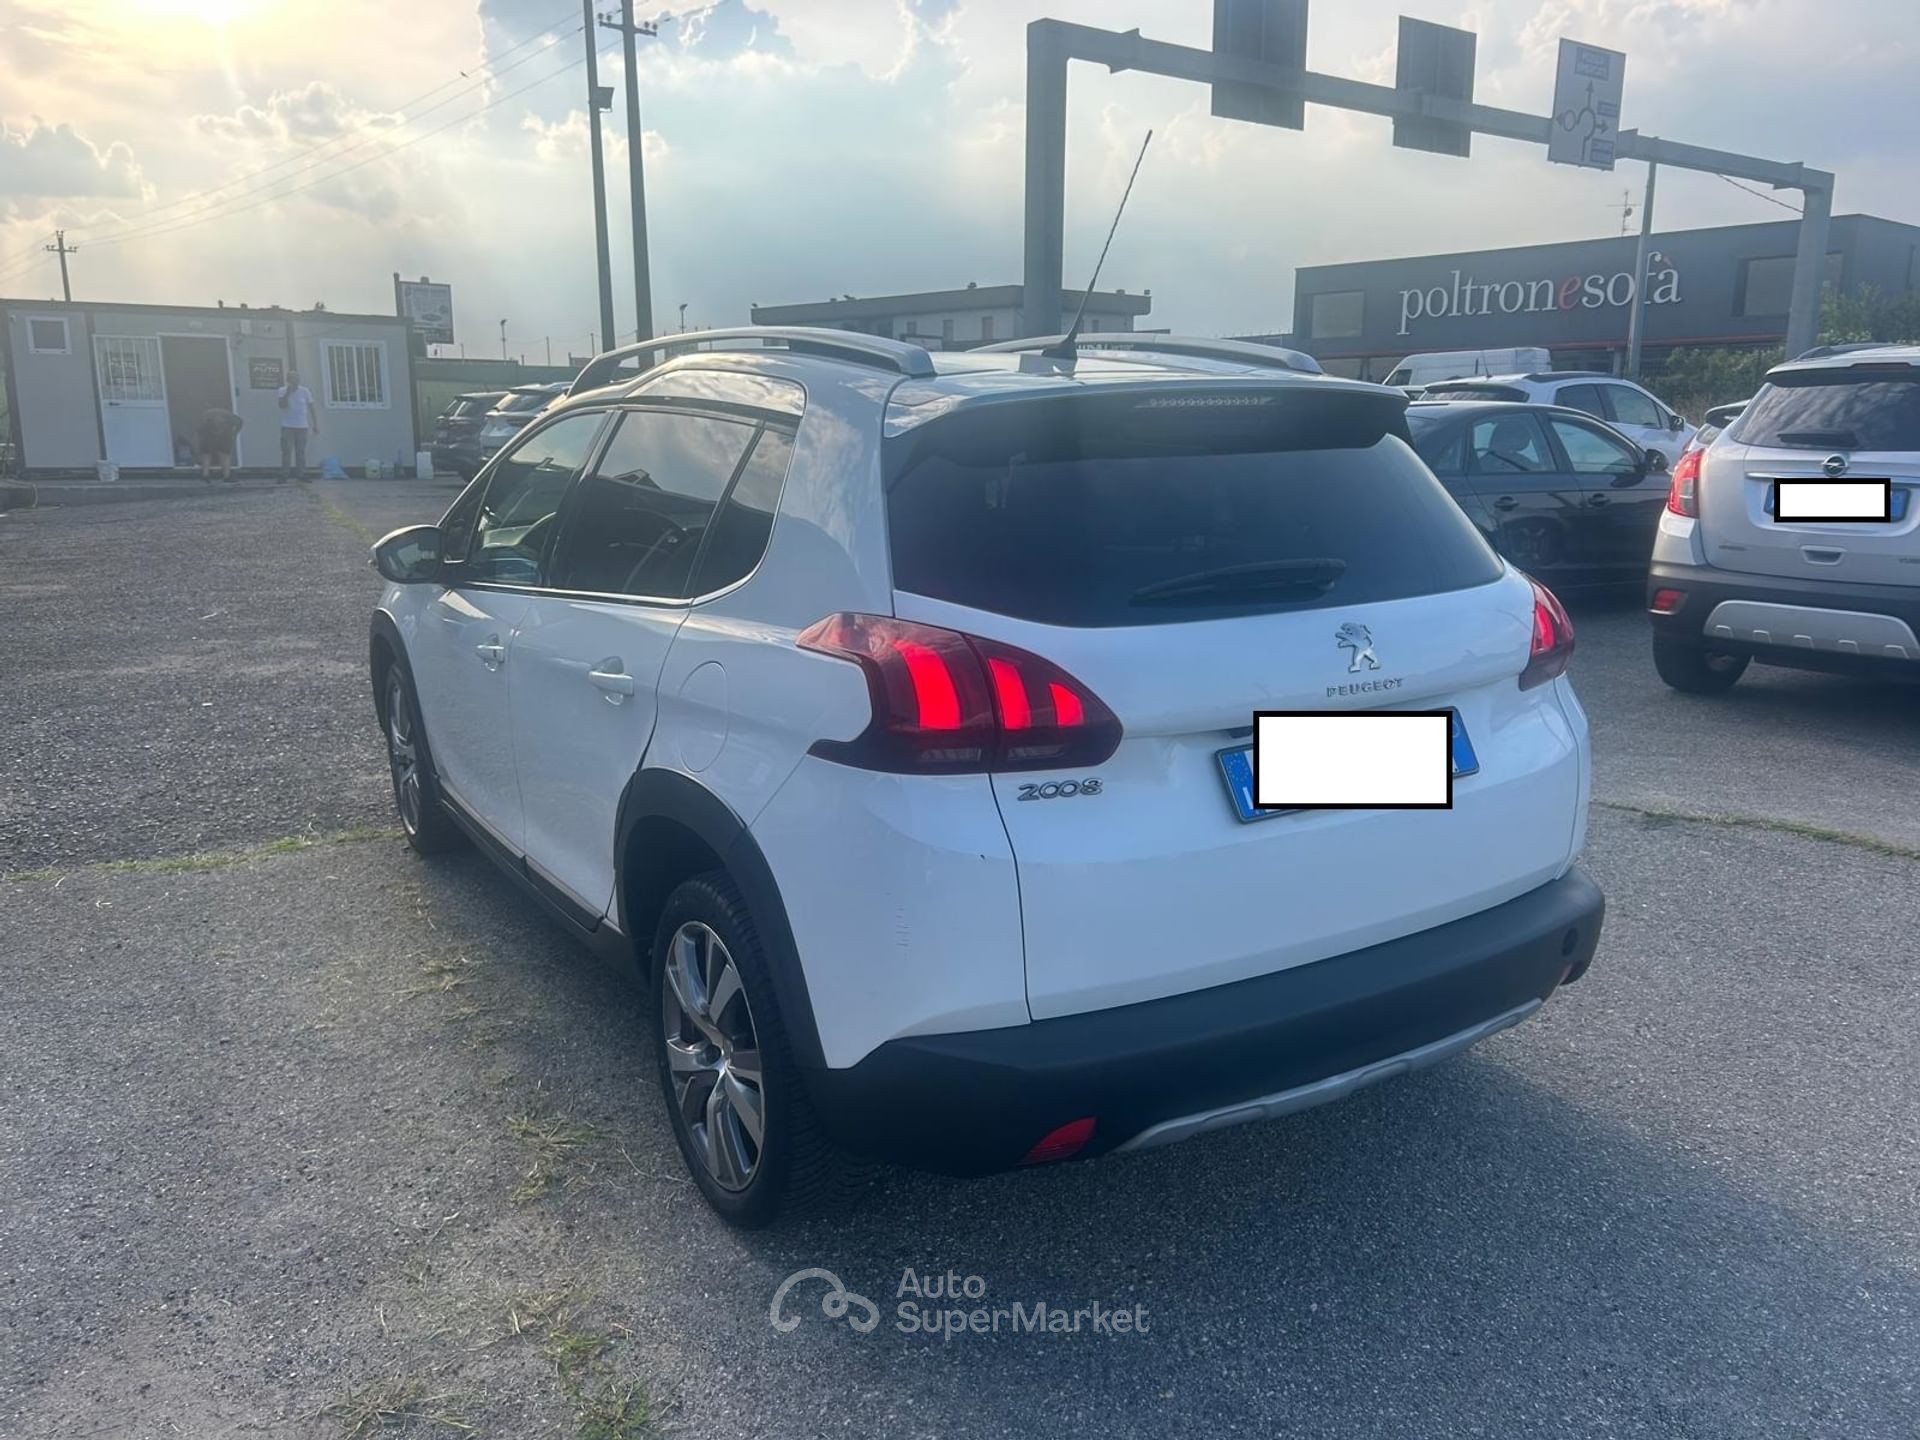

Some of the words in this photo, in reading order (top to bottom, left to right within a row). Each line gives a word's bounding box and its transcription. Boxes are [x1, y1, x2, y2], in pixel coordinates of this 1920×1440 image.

[1396, 250, 1682, 335] poltronesofà
[1326, 677, 1403, 698] PEUGEOT
[1017, 777, 1103, 801] 2008
